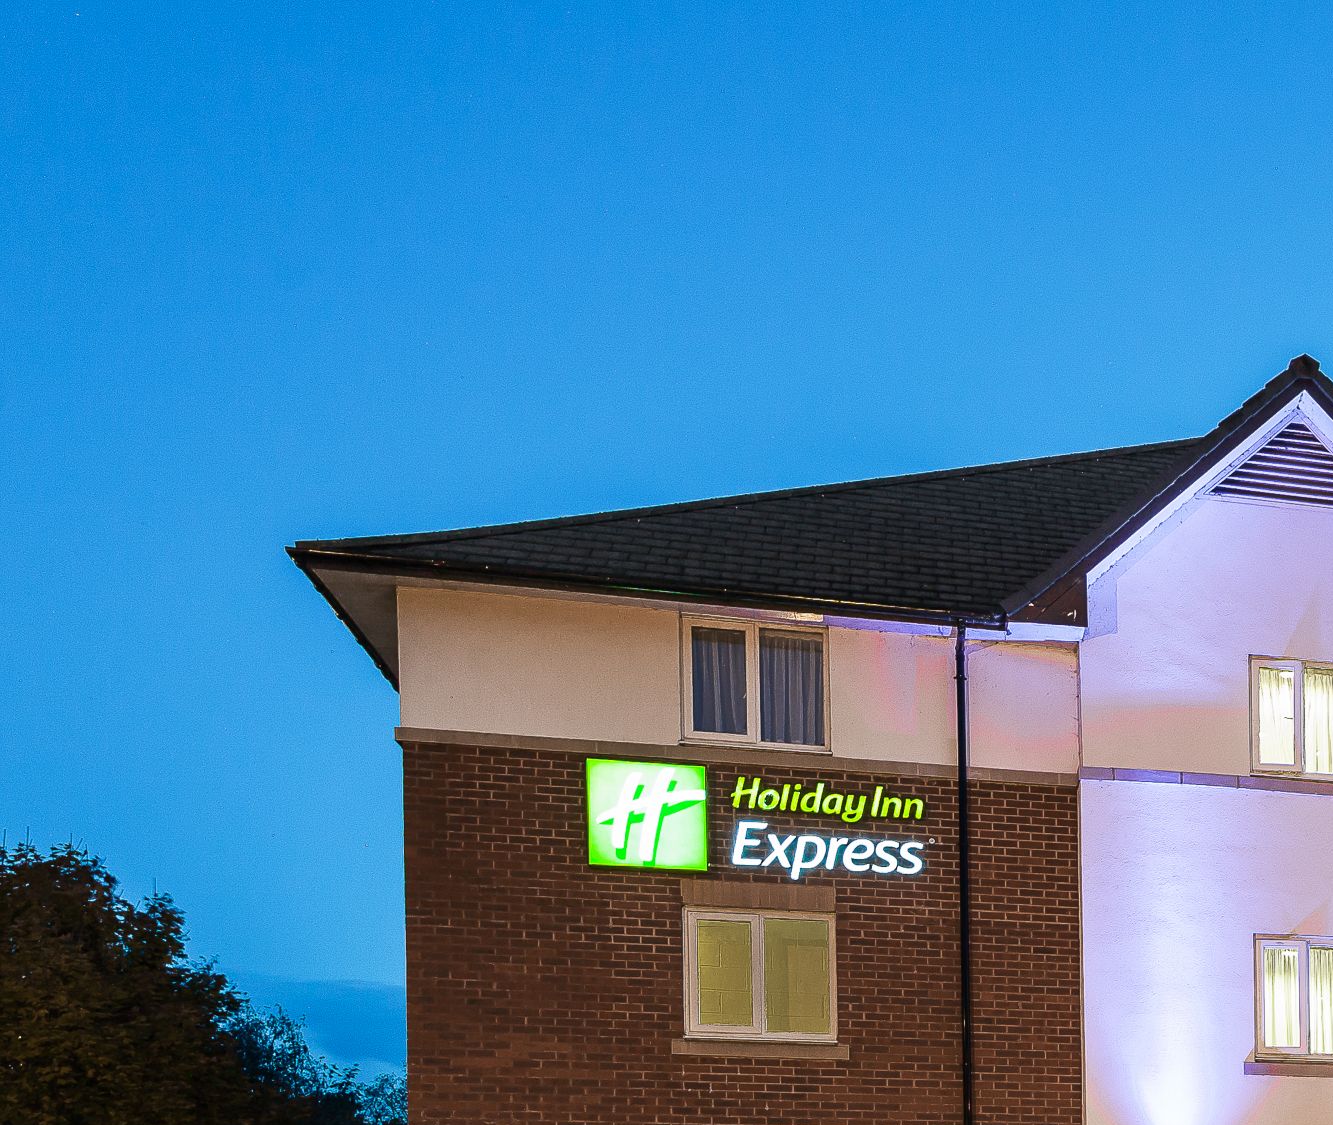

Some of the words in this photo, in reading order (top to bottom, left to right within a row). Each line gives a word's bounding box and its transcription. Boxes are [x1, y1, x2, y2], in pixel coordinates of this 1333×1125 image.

[730, 776, 867, 823] Holiday
[870, 785, 925, 820] Inn
[732, 820, 924, 881] Express
